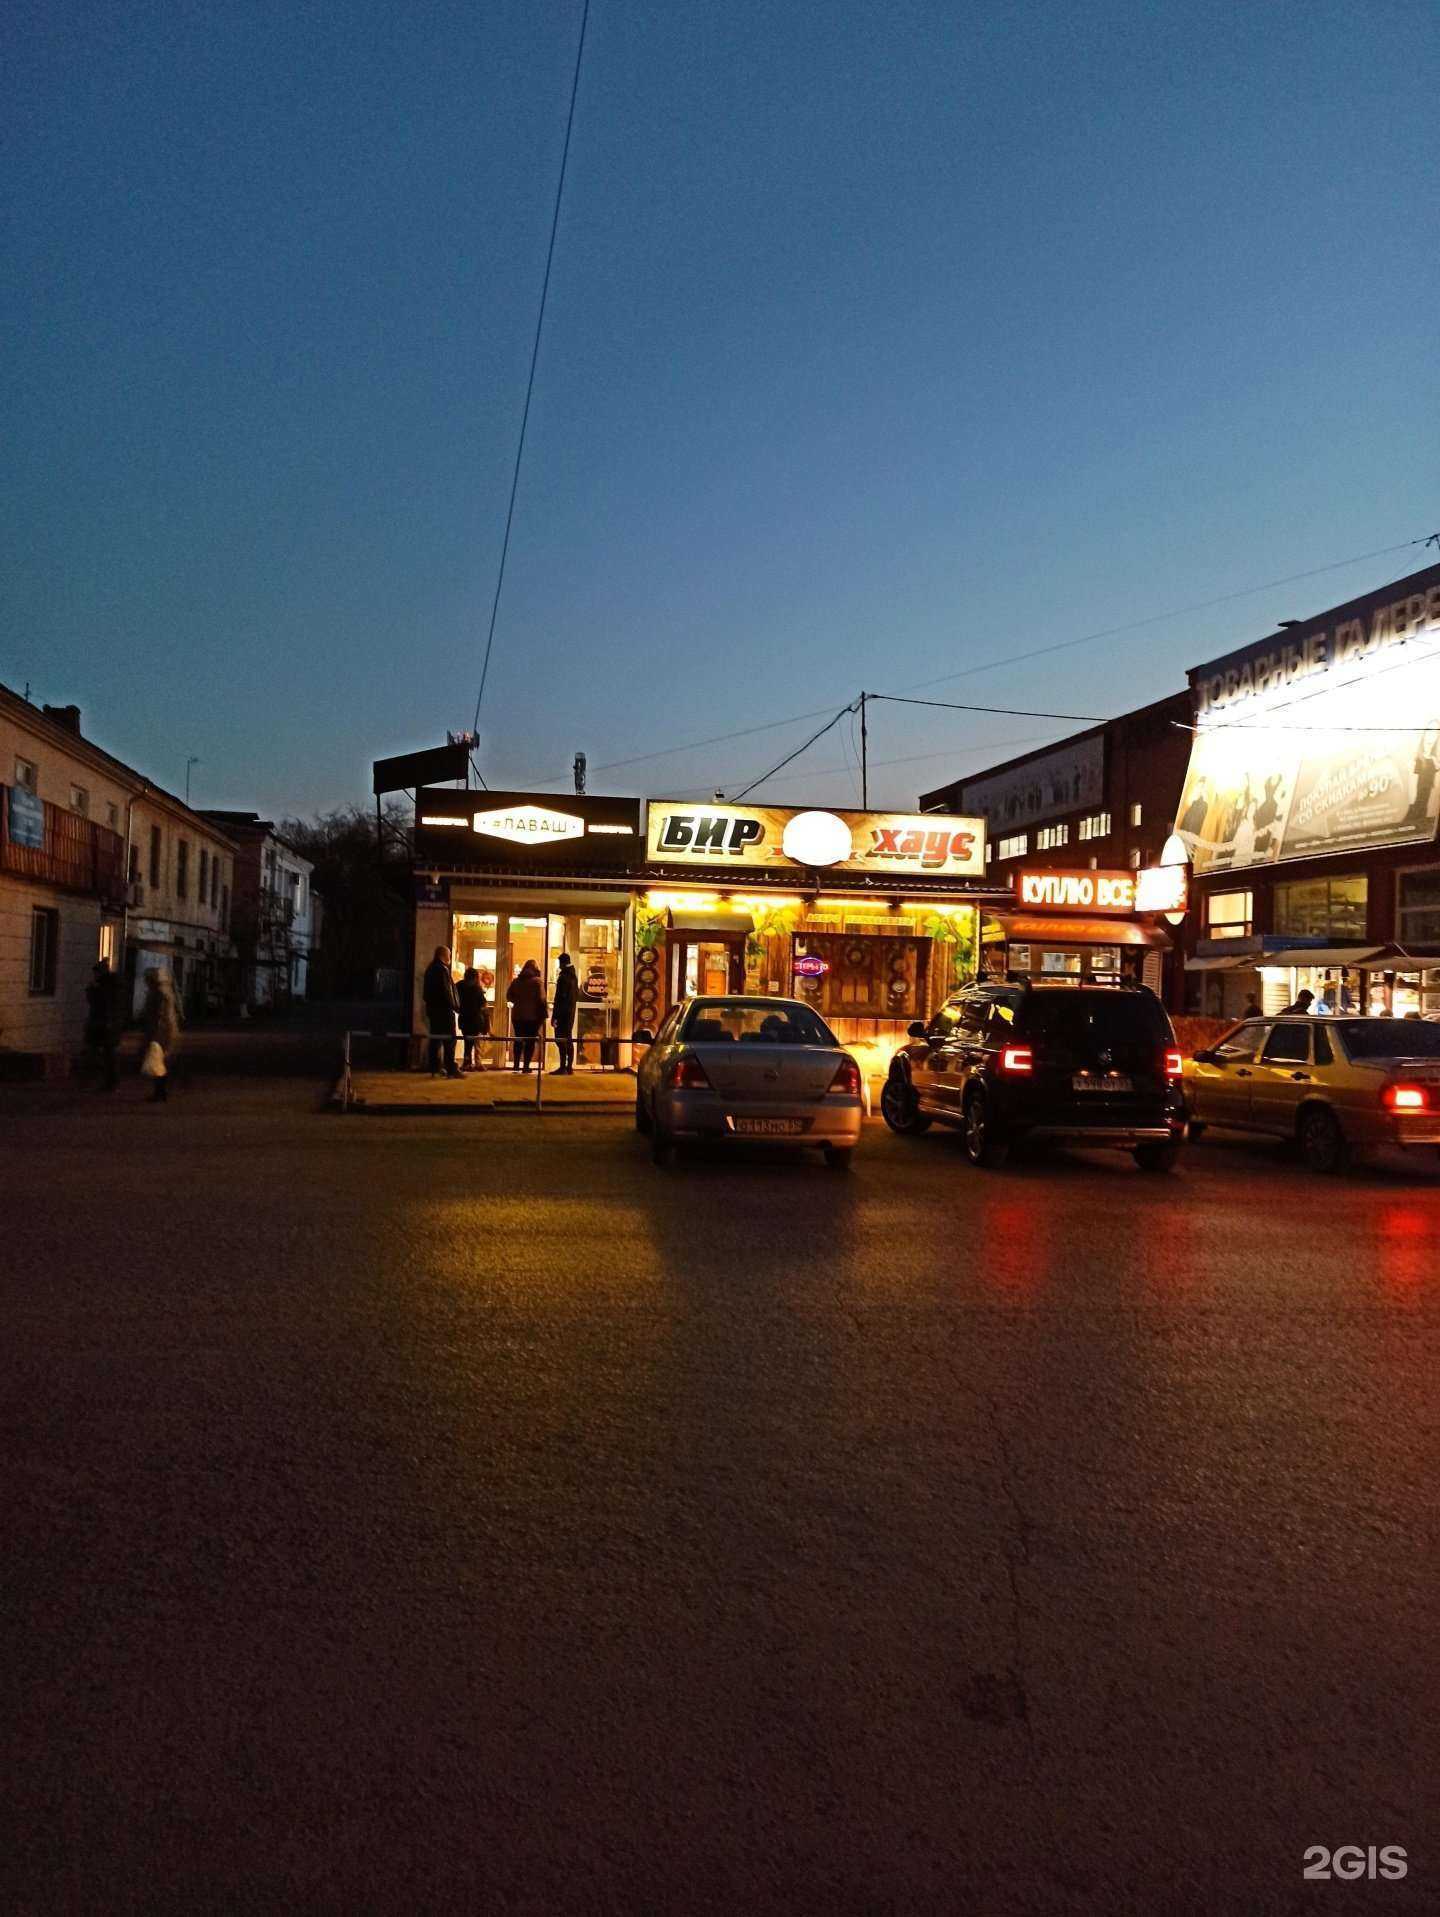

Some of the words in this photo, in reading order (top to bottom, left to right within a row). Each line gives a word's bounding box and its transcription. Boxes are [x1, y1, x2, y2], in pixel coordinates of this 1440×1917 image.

[1197, 631, 1327, 714] ТОВАРНЫЕ
[657, 815, 765, 856] БИР
[1022, 875, 1094, 905] КУПЛЮ
[1097, 878, 1133, 907] ВСЕ
